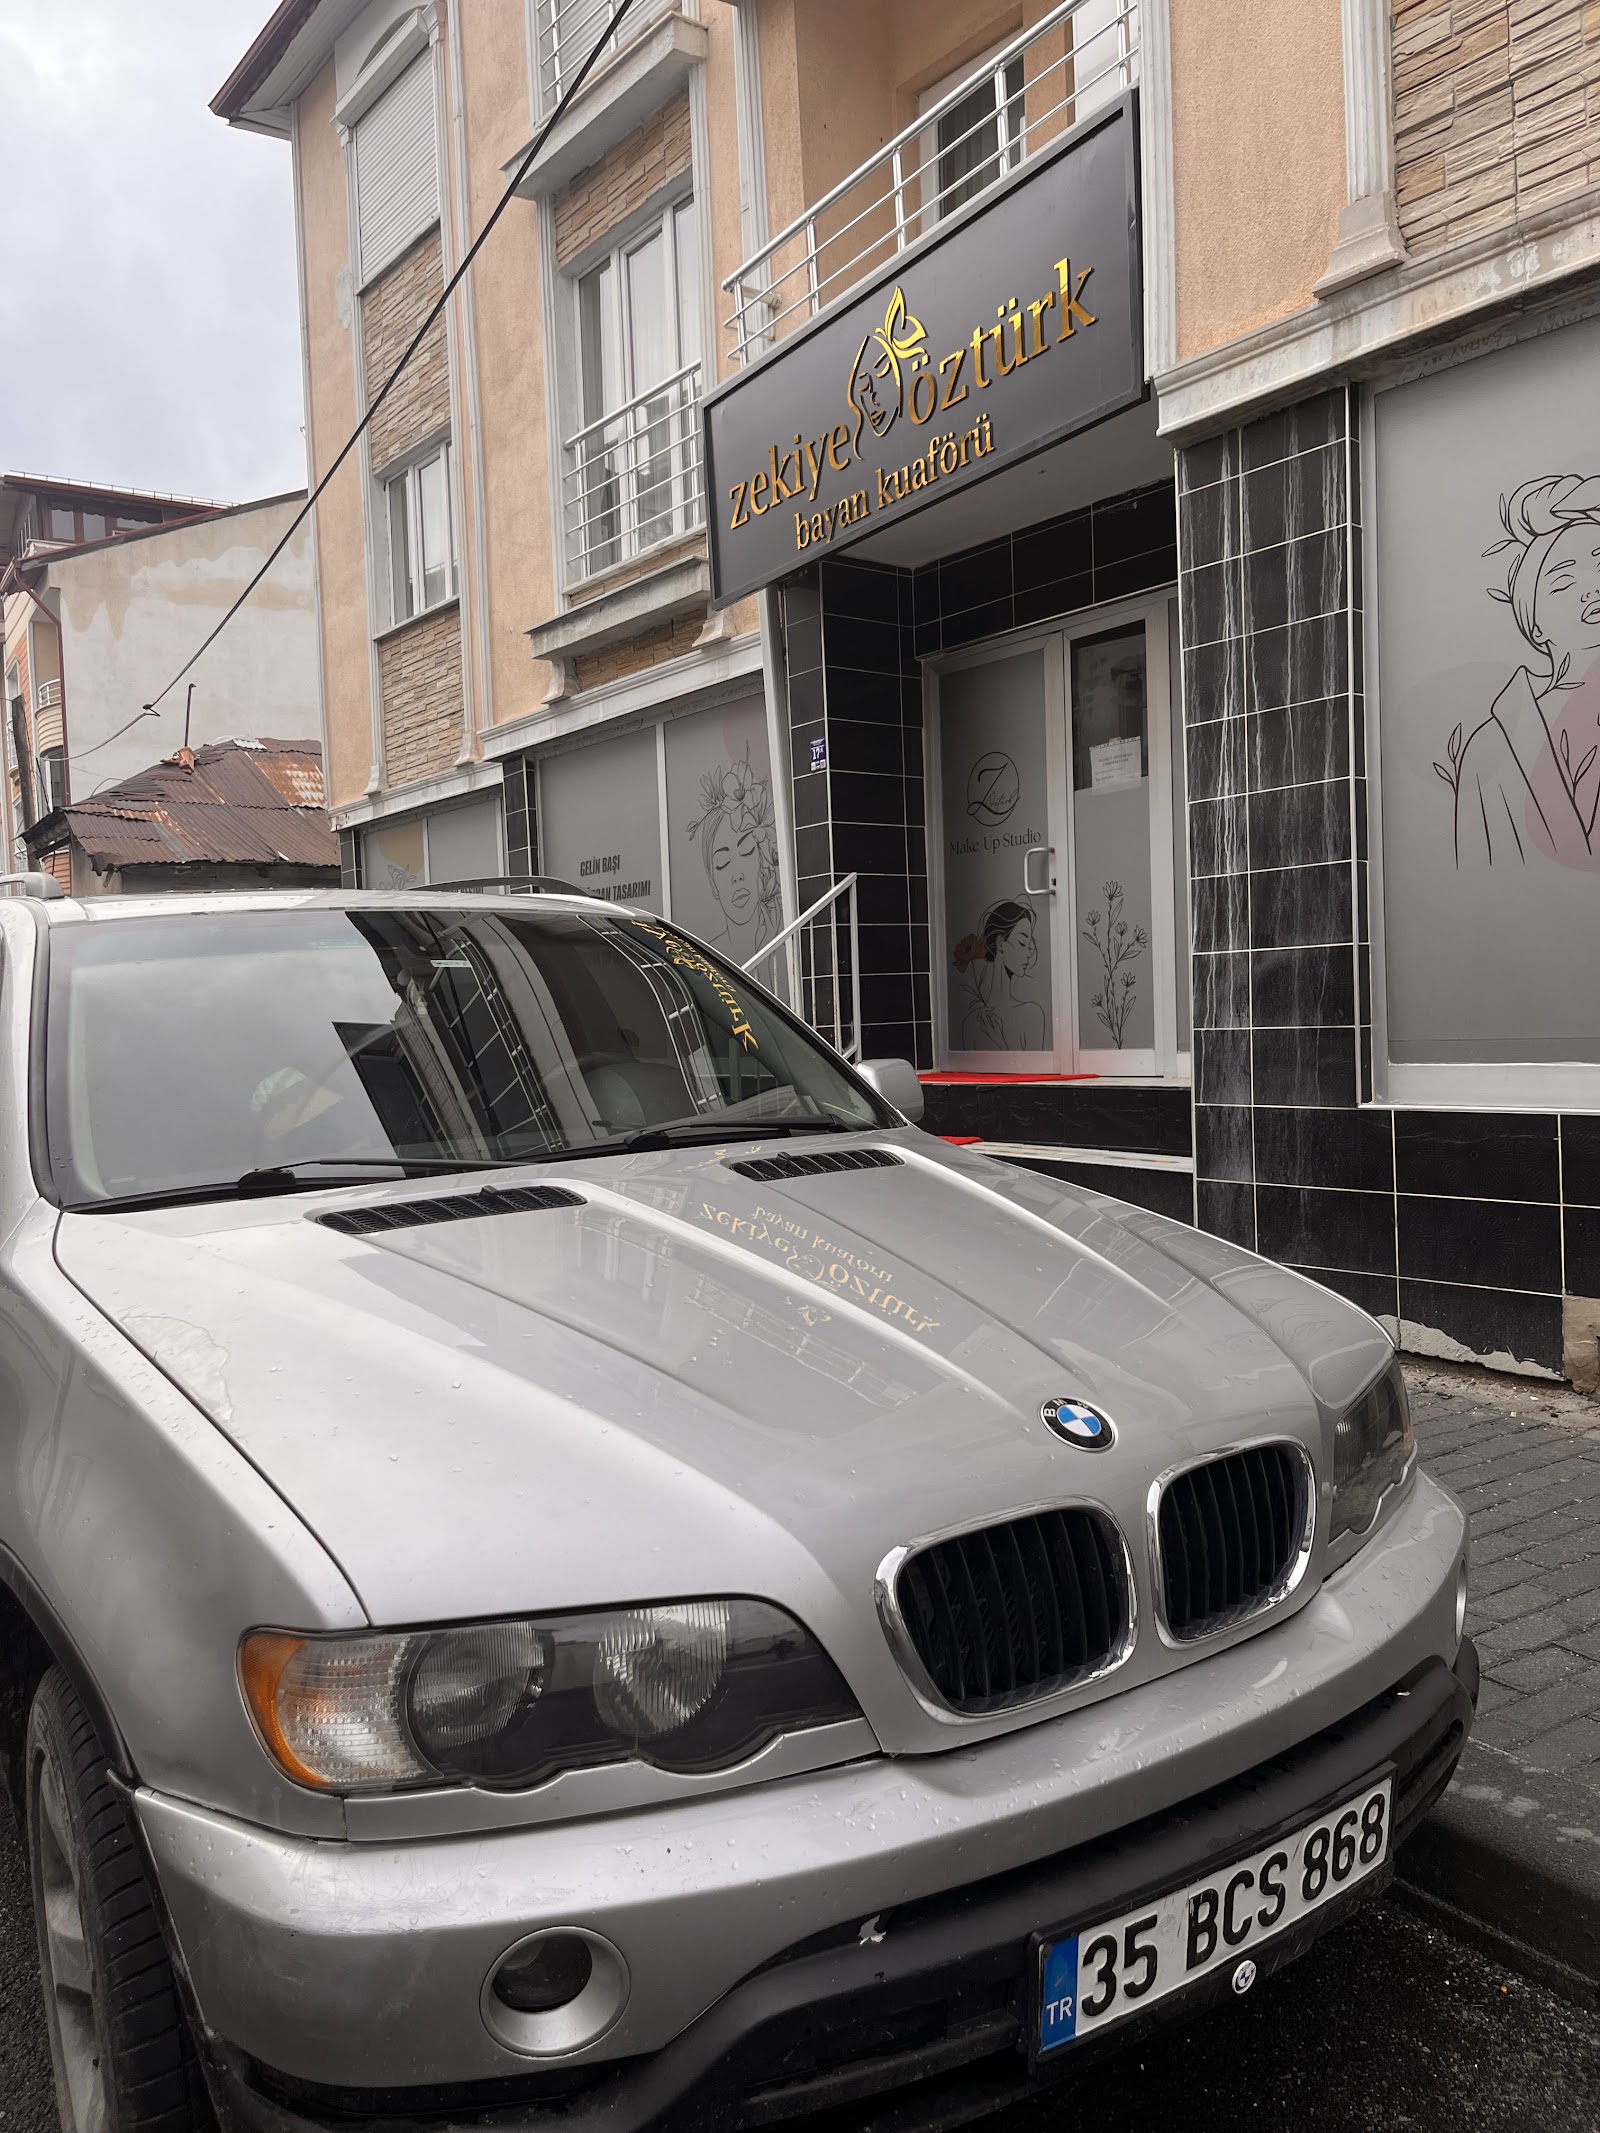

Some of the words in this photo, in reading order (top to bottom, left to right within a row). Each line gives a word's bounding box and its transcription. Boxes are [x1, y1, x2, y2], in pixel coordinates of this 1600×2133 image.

[728, 423, 850, 530] zekiye
[908, 257, 1099, 427] öztürk
[794, 489, 869, 550] bayan
[876, 413, 995, 511] kuaförü
[950, 838, 980, 855] Make
[983, 836, 1000, 855] Up
[1003, 828, 1042, 848] Studio
[580, 856, 601, 877] GELİN
[602, 855, 620, 875] BAŞI
[613, 880, 651, 901] TASARIMI
[1080, 1914, 1159, 2017] 35
[1186, 1852, 1288, 1971] BCS
[1301, 1793, 1386, 1901] 868
[1046, 1996, 1073, 2026] TR
